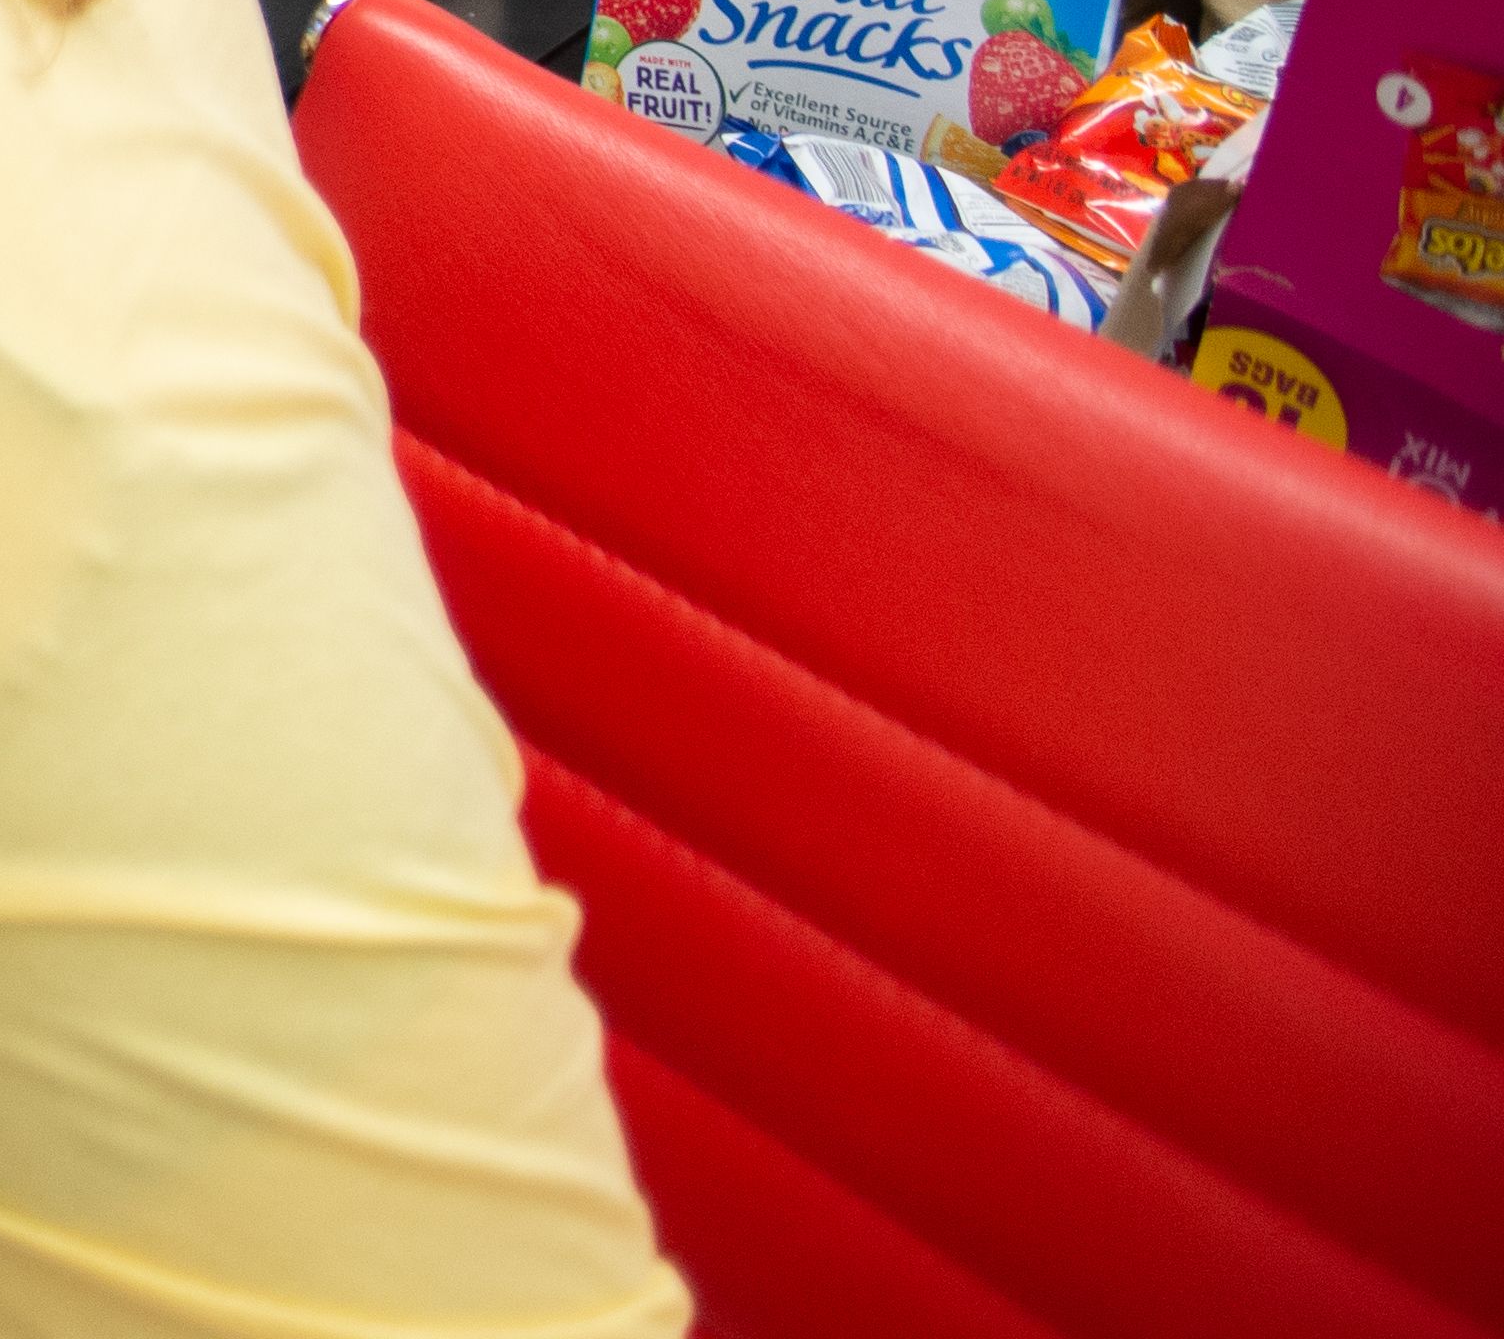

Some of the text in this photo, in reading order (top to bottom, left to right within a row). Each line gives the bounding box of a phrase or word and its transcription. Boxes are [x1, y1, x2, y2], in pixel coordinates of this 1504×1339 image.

[638, 53, 693, 69] MADE WITH
[636, 66, 703, 97] REAL
[1395, 83, 1416, 114] 4
[626, 92, 713, 126] FRUIT!
[749, 97, 769, 113] of
[768, 102, 852, 136] Vitamins
[752, 80, 914, 139] Excellent Source
[1227, 348, 1322, 411] BAGS
[1387, 428, 1472, 489] MIX
